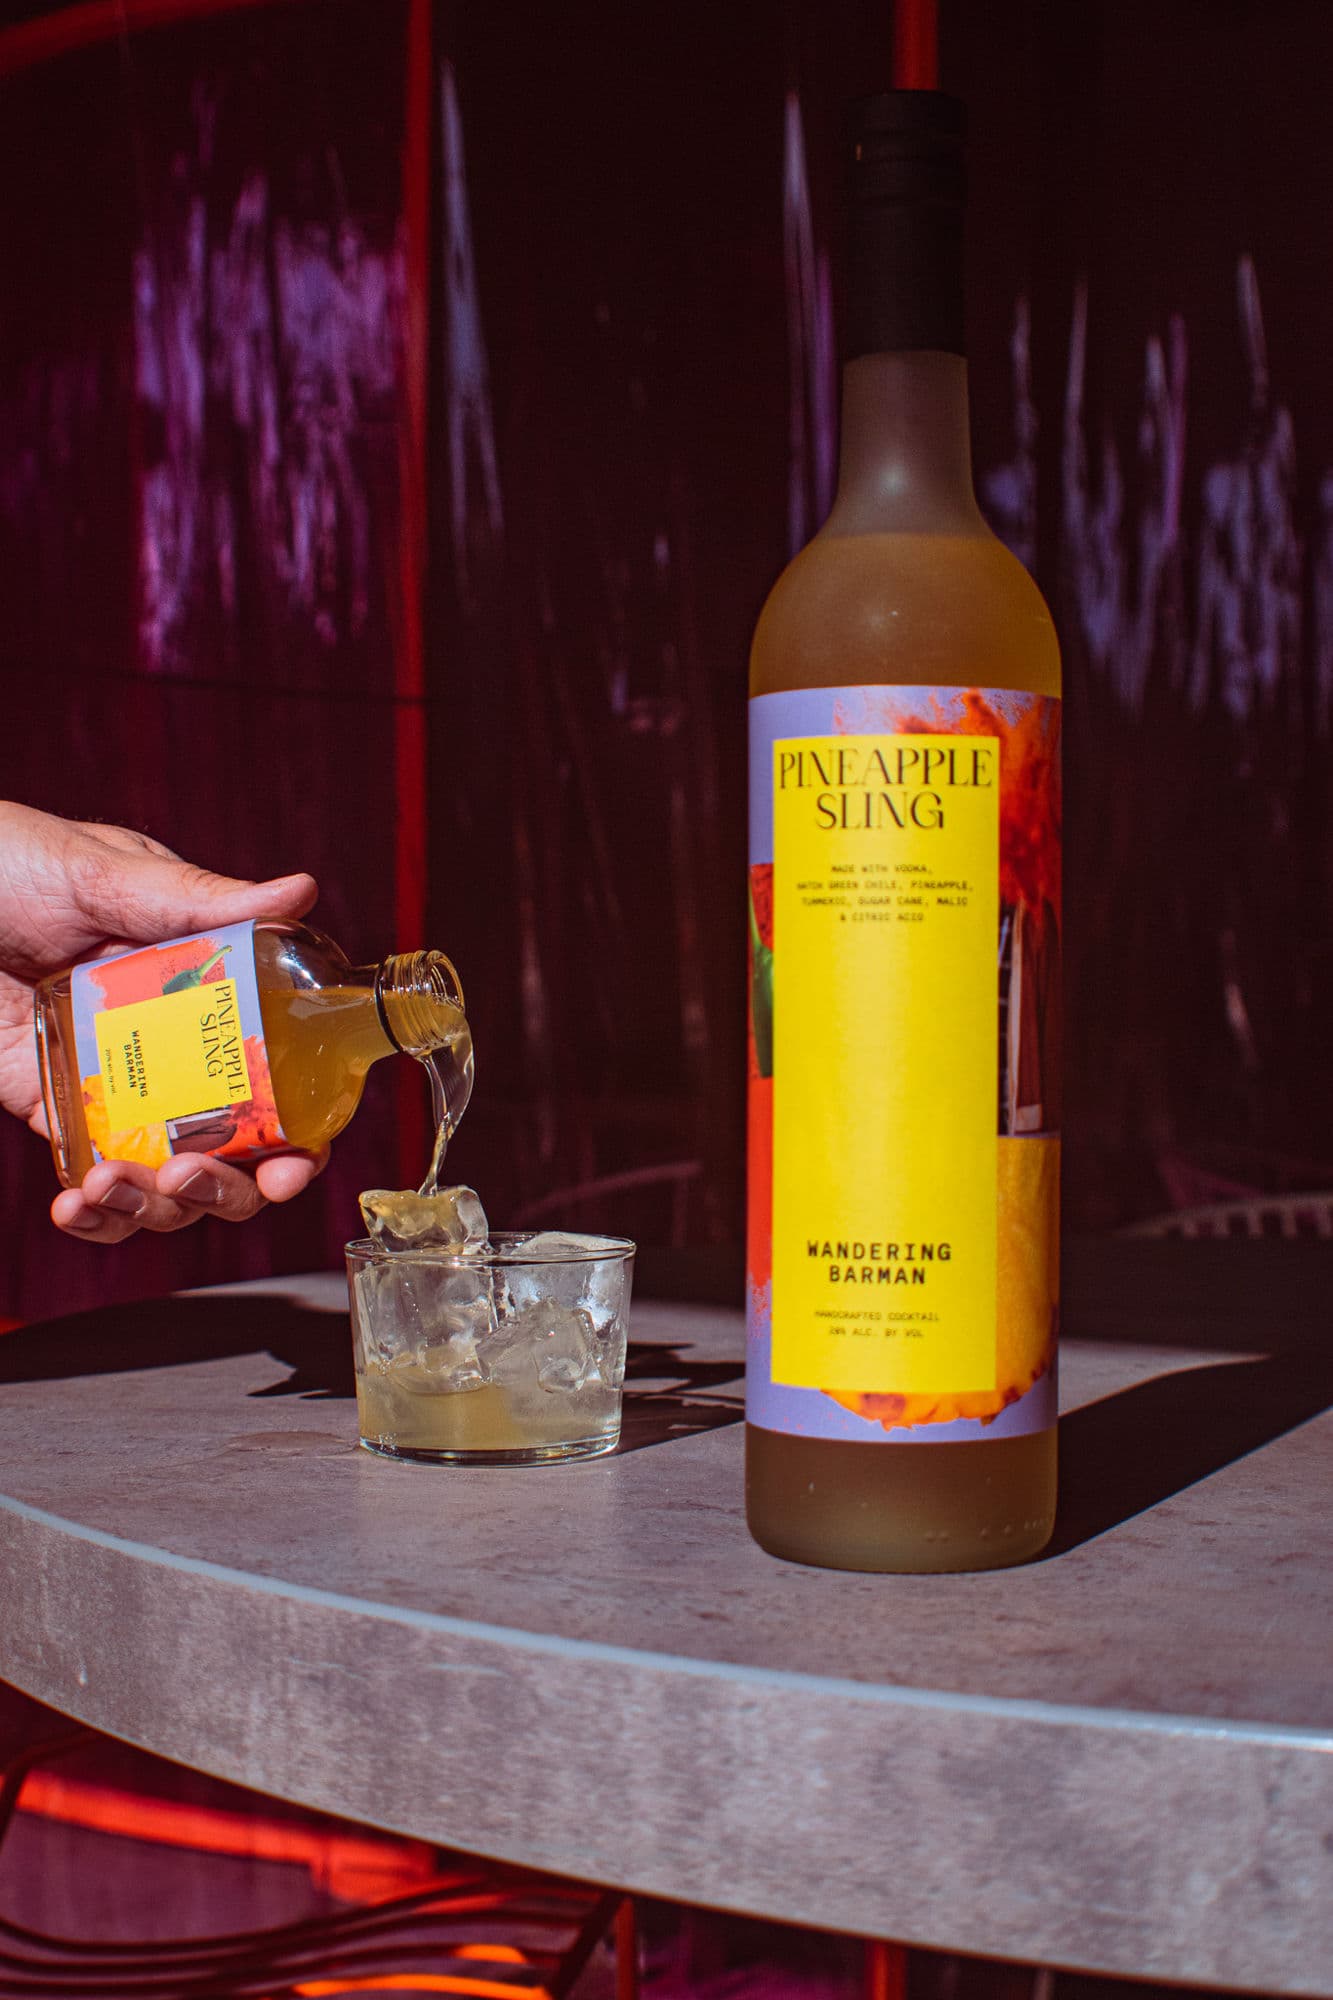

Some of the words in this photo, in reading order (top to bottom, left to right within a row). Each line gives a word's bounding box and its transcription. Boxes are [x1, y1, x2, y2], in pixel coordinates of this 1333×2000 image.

[780, 748, 993, 789] PINEAPPLE
[815, 791, 944, 830] SLING
[830, 864, 855, 873] MADE
[861, 864, 888, 873] WITH
[894, 864, 933, 875] VODKA,
[828, 880, 858, 889] GREEN
[911, 880, 974, 892] PINEAPPLE,
[857, 896, 890, 905] SUGAR
[896, 896, 928, 907] CANE,
[936, 896, 968, 905] MALIC
[851, 912, 890, 921] CITRIC
[897, 912, 924, 921] ACID
[200, 1013, 224, 1078] SLING
[215, 985, 247, 1097] PINEAPPLE
[123, 1044, 136, 1088] BARMAN
[132, 1030, 148, 1097] WANDERING
[806, 1239, 952, 1261] WANDERING
[829, 1265, 925, 1285] BARMAN
[815, 1311, 881, 1320] HANDCRAFTED
[888, 1312, 940, 1321] COCKTAIL
